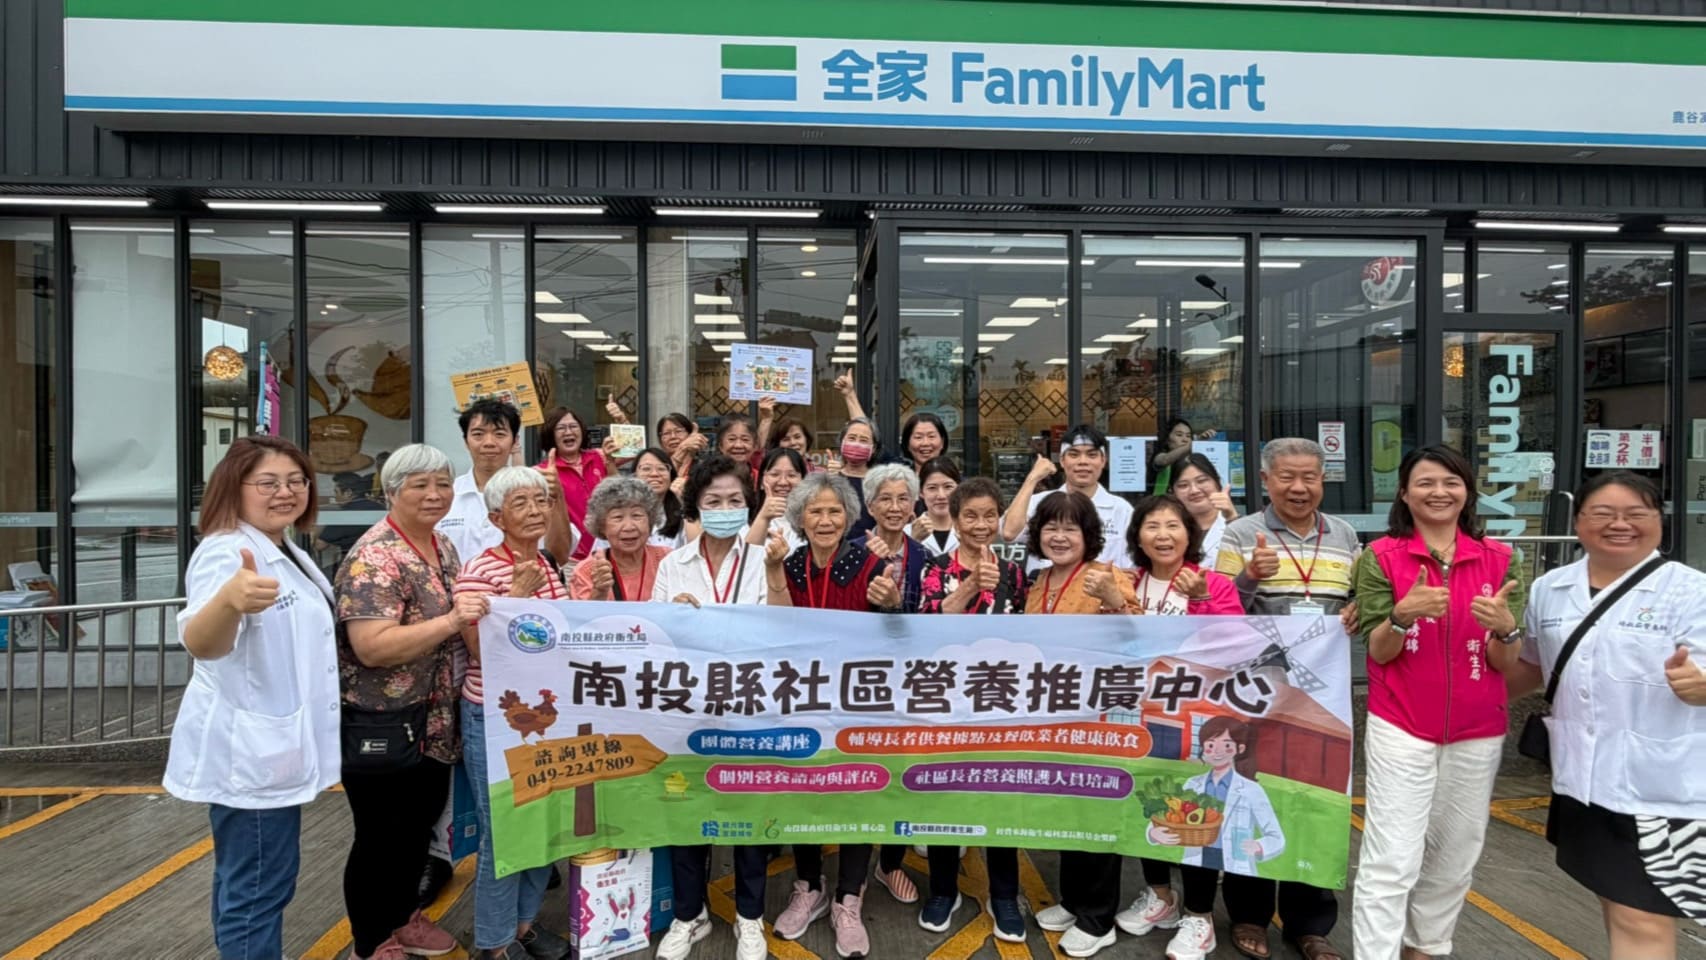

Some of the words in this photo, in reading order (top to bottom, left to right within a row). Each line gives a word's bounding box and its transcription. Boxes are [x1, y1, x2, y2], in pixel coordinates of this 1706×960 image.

[822, 48, 928, 102] 全家
[951, 51, 1266, 116] FamilyMart
[561, 632, 647, 643] 南投縣政府衛生局
[1467, 638, 1481, 681] 衛生局
[568, 659, 1273, 716] 南投縣社區營養推廣中心
[701, 733, 811, 751] 團體營養講座
[848, 729, 1139, 749] 輔導長者供餐據點及餐飲業者健康飲食
[534, 739, 623, 767] 諮詢專線
[527, 756, 635, 788] 049-2247809
[719, 769, 878, 787] 個別營養諮詢與評估
[914, 768, 1120, 790] 社區長者營養照護人員培訓
